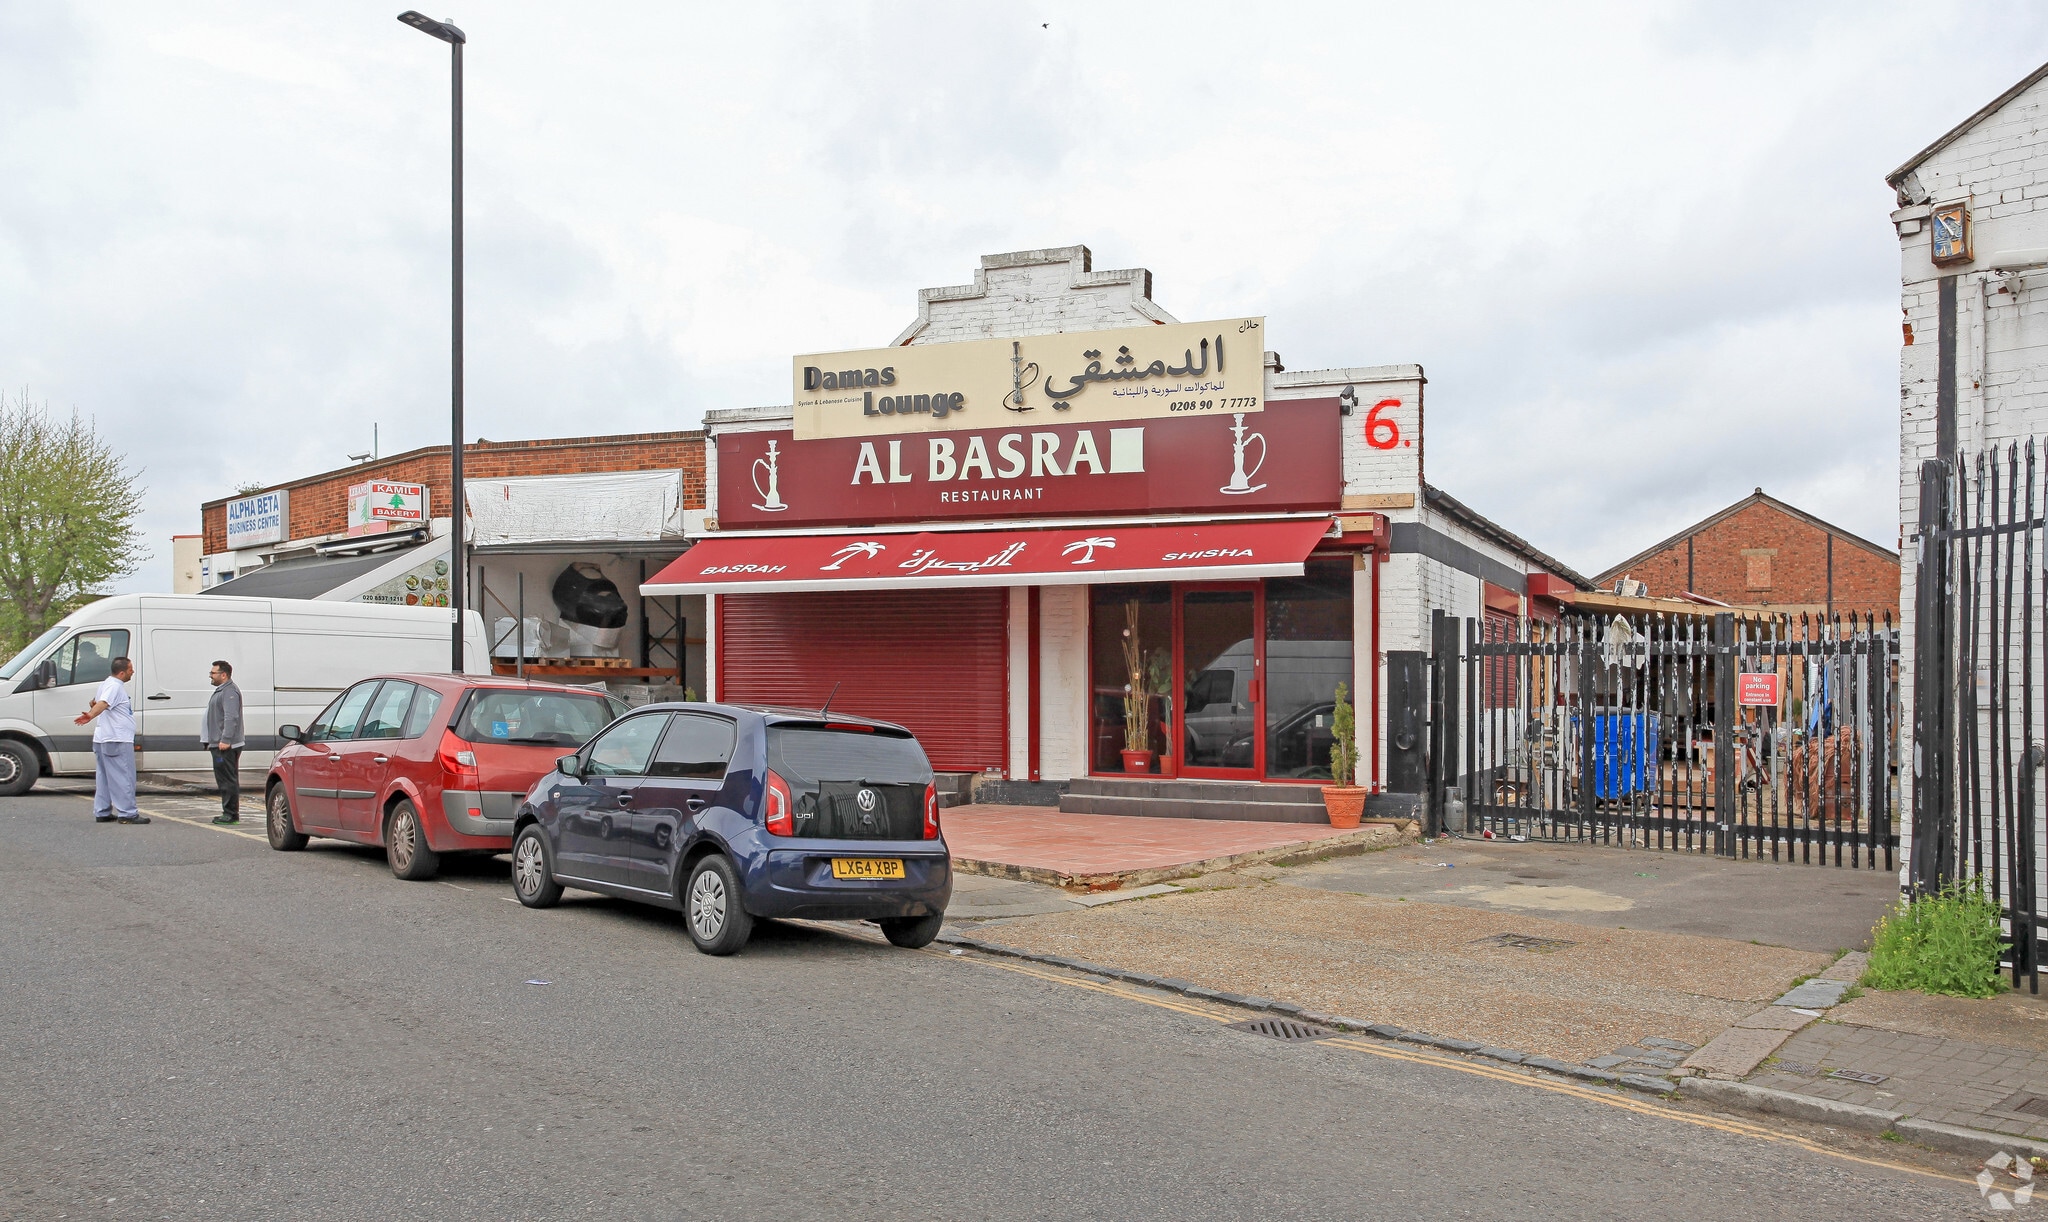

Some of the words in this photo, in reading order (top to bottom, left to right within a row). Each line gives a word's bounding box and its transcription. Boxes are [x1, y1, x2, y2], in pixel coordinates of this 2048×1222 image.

[1238, 319, 1260, 334] حلال
[803, 366, 896, 391] Damas
[1044, 334, 1224, 411] الدمشقي
[863, 391, 965, 418] Lounge
[1170, 401, 1197, 412] 0208
[1200, 400, 1213, 410] 90
[1230, 397, 1257, 408] 7773
[850, 440, 913, 485] AL
[927, 430, 1106, 482] BASRA
[377, 484, 415, 495] KAMIL
[941, 487, 1043, 503] RESTAURANT
[229, 500, 256, 520] ALPHA
[257, 494, 279, 515] BETA
[377, 508, 416, 517] BAKERY
[229, 519, 256, 534] BUSINESS
[257, 515, 279, 530] CENTRE
[898, 541, 1027, 575] البصرة
[1161, 548, 1254, 560] SHISHA
[700, 563, 787, 575] BASRAH
[1745, 683, 1770, 691] parking
[838, 861, 872, 875] LX64
[876, 861, 898, 875] XBP
